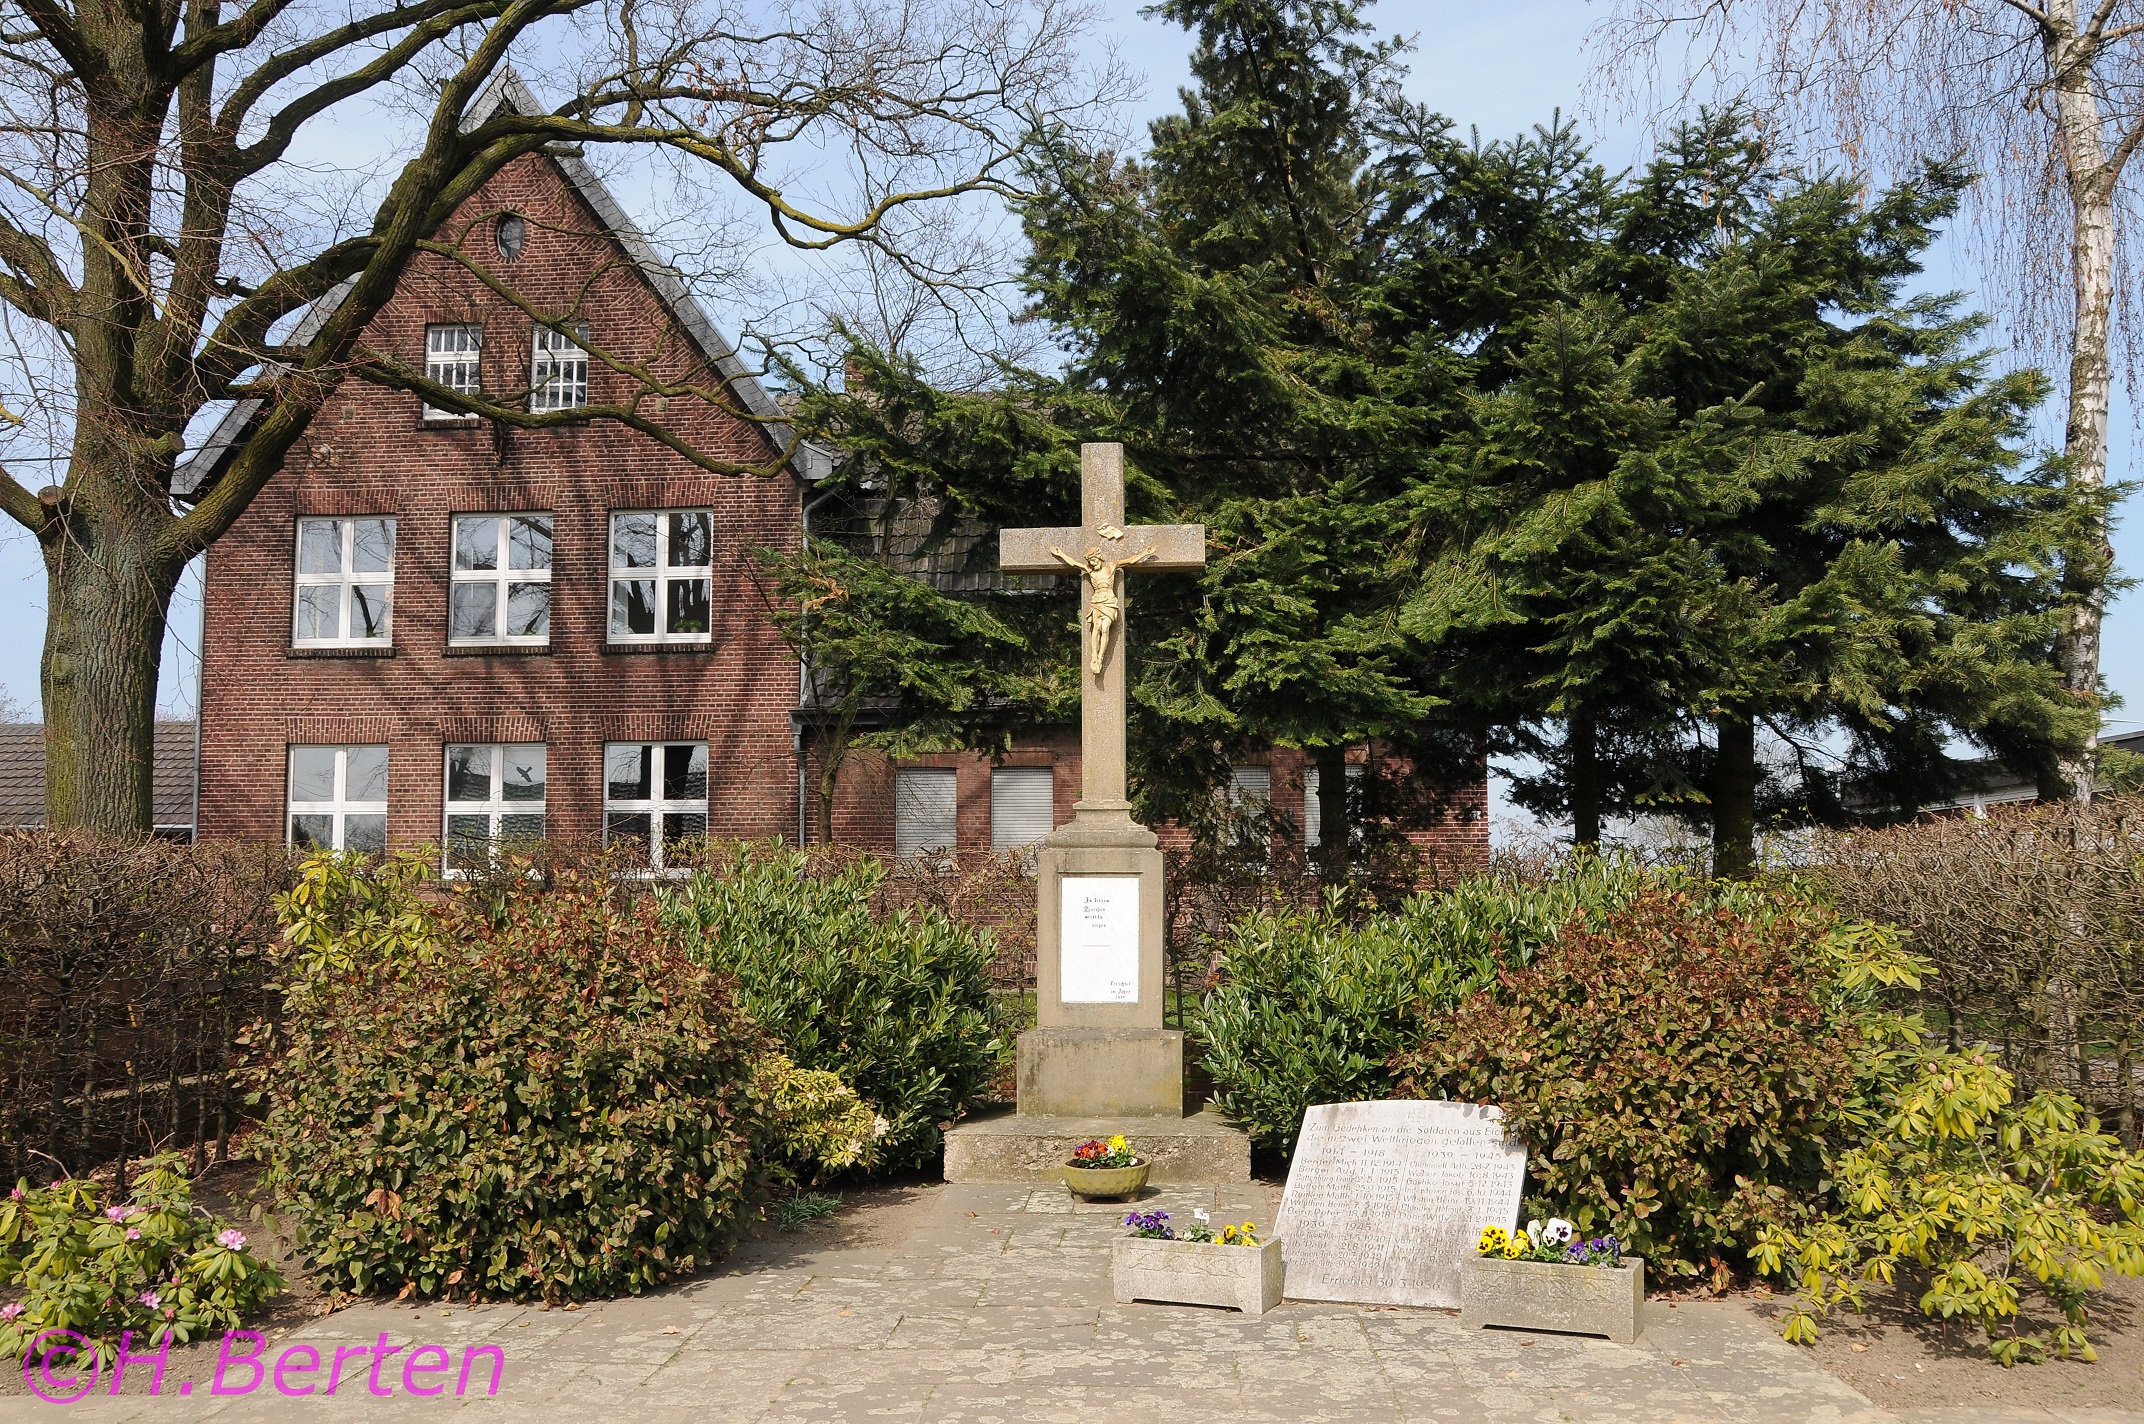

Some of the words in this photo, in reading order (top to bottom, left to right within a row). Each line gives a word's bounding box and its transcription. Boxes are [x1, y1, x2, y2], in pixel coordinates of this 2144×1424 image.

[1310, 1122, 1330, 1132] Zum
[1332, 1124, 1379, 1133] Gedenken
[1396, 1124, 1412, 1134] die
[1417, 1126, 1460, 1135] Soldaten
[1462, 1128, 1482, 1136] aus
